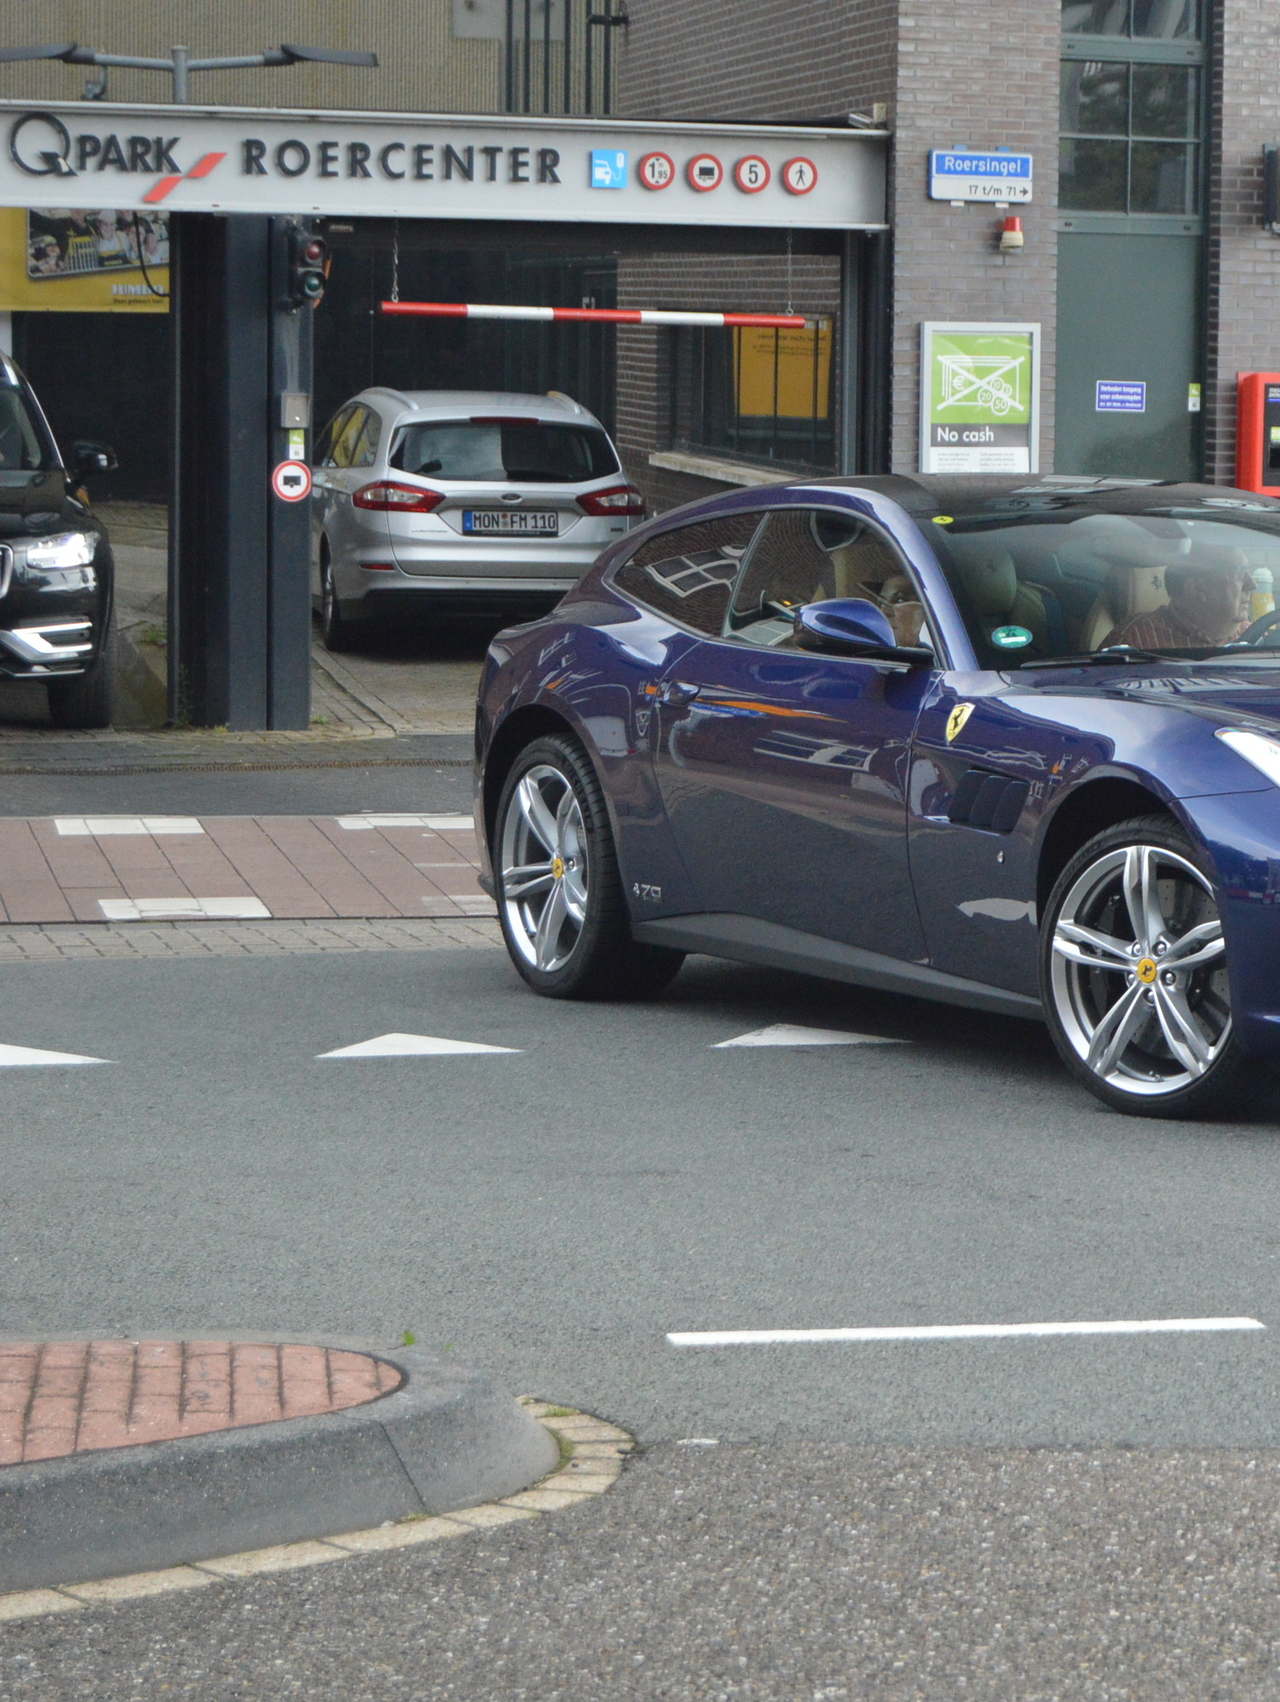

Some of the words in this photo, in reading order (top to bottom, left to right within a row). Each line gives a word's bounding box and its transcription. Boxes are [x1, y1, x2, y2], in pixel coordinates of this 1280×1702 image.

[242, 138, 562, 183] ROERCENTER
[944, 156, 1021, 176] Roersingel
[748, 164, 758, 184] 5
[969, 185, 978, 195] 17
[982, 185, 1002, 196] t/m
[1006, 187, 1016, 196] 71
[981, 391, 992, 401] 20
[994, 399, 1007, 410] 50
[937, 427, 959, 442] No
[963, 426, 994, 442] cash
[473, 514, 500, 528] MON
[510, 514, 527, 529] FM
[531, 515, 556, 529] 110
